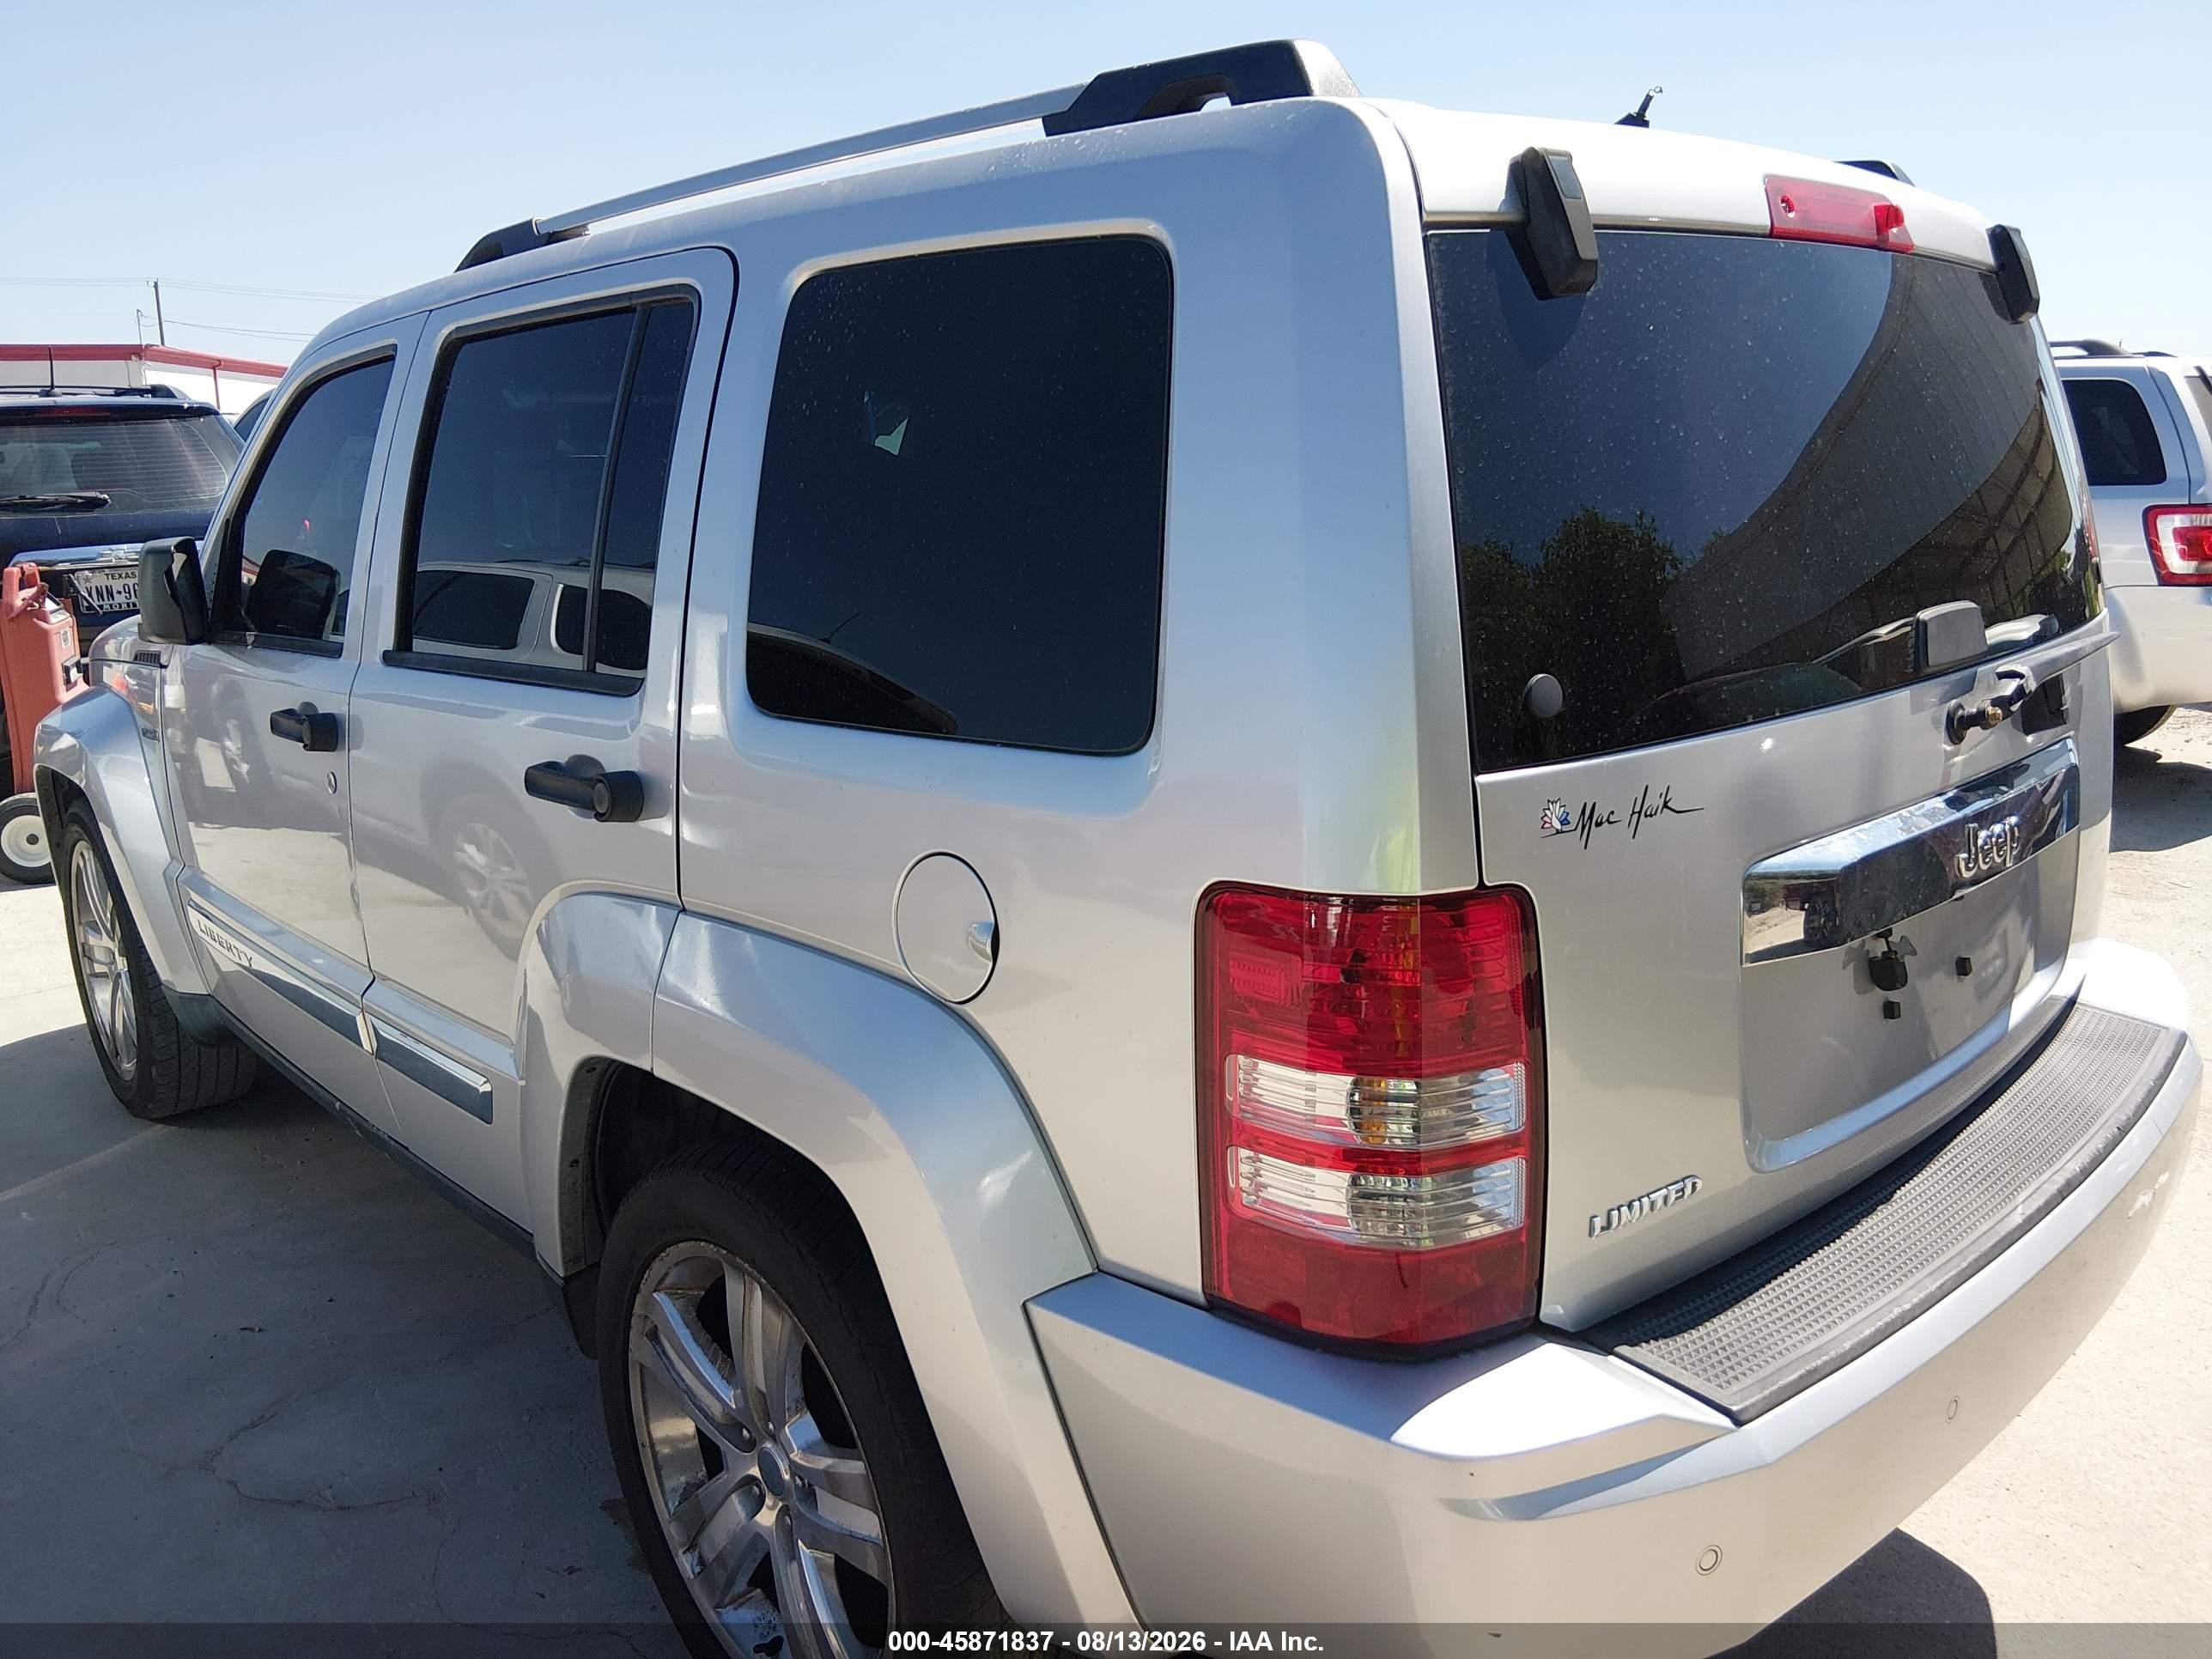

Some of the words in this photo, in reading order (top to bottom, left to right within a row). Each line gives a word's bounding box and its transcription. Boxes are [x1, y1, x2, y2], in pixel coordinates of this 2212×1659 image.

[85, 585, 115, 603] XNN
[104, 571, 137, 580] TEXAS
[1573, 801, 1622, 850] Mac
[1628, 784, 1705, 840] Haik
[1954, 816, 2021, 878] Jeep
[196, 917, 253, 968] LIBERTY
[1589, 1174, 1704, 1239] LIMITED
